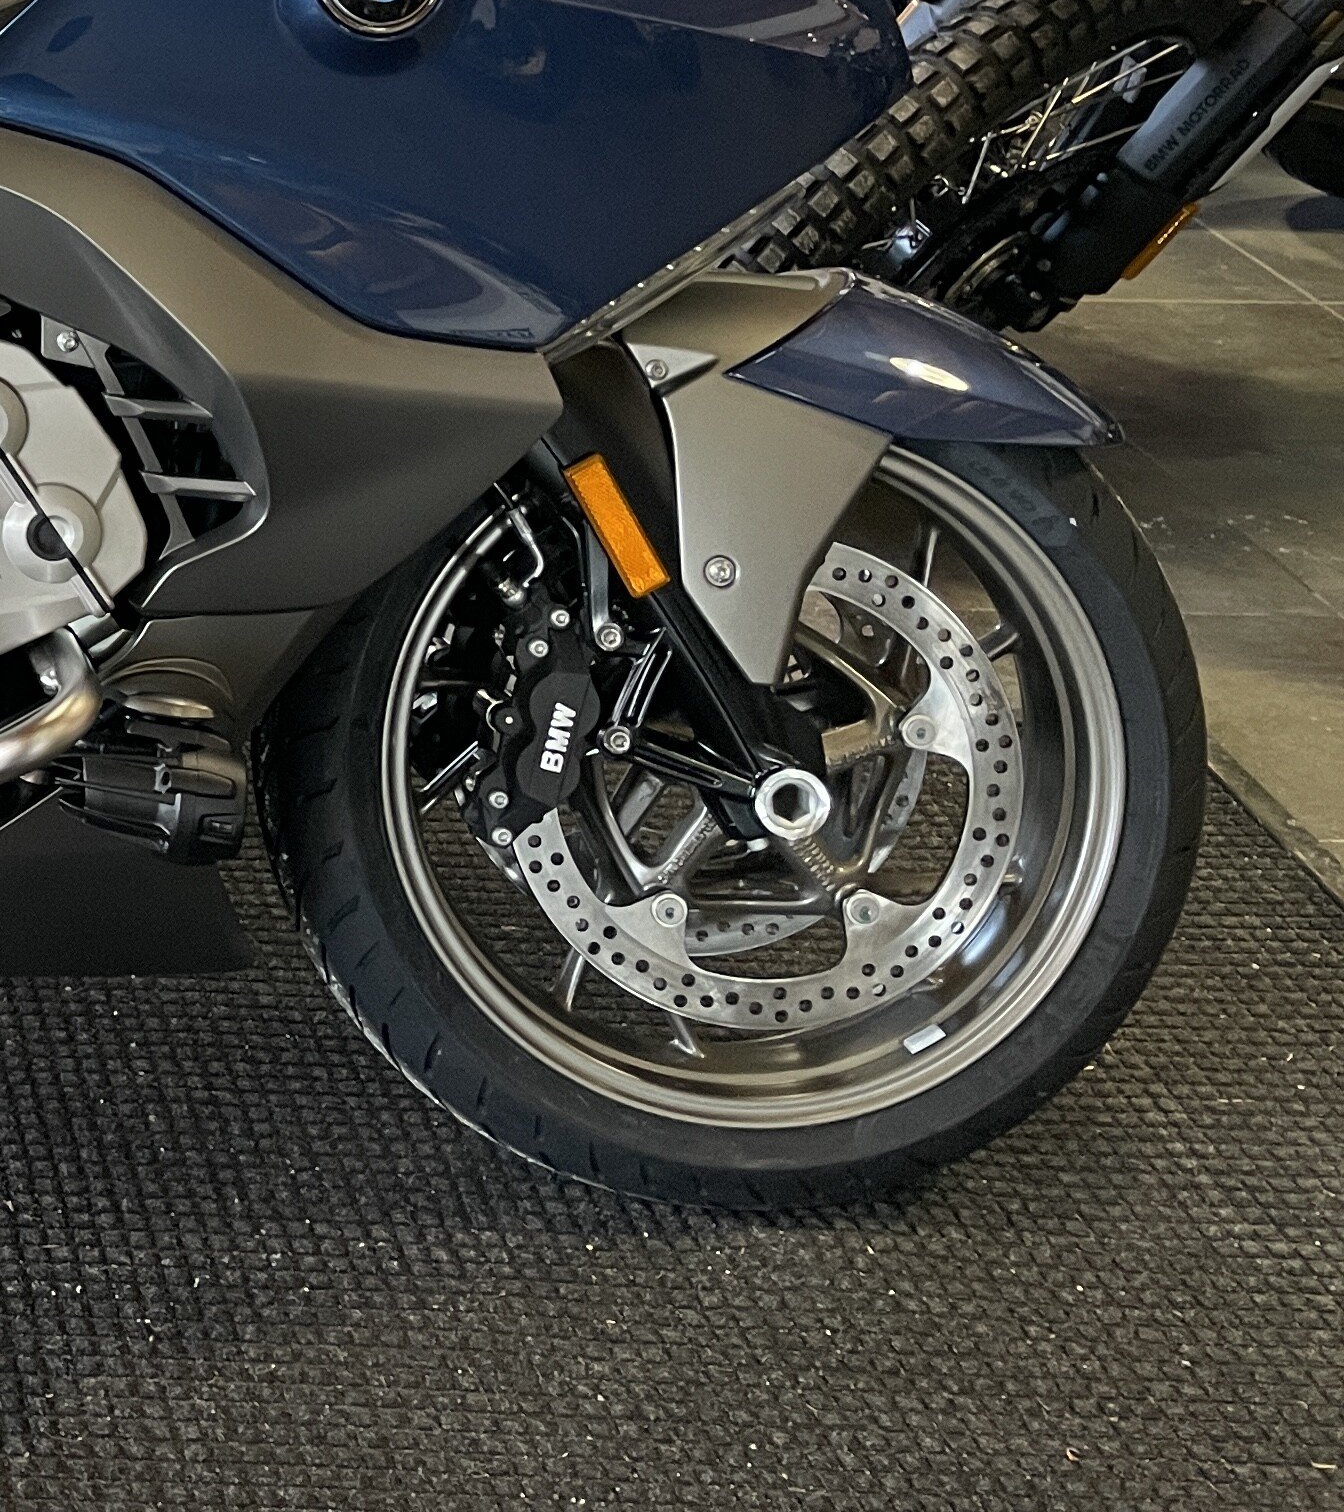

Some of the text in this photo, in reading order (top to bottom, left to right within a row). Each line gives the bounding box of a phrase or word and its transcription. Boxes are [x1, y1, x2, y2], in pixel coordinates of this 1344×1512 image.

[1143, 58, 1250, 172] BMW MOTORRAD
[539, 702, 577, 774] BMW
